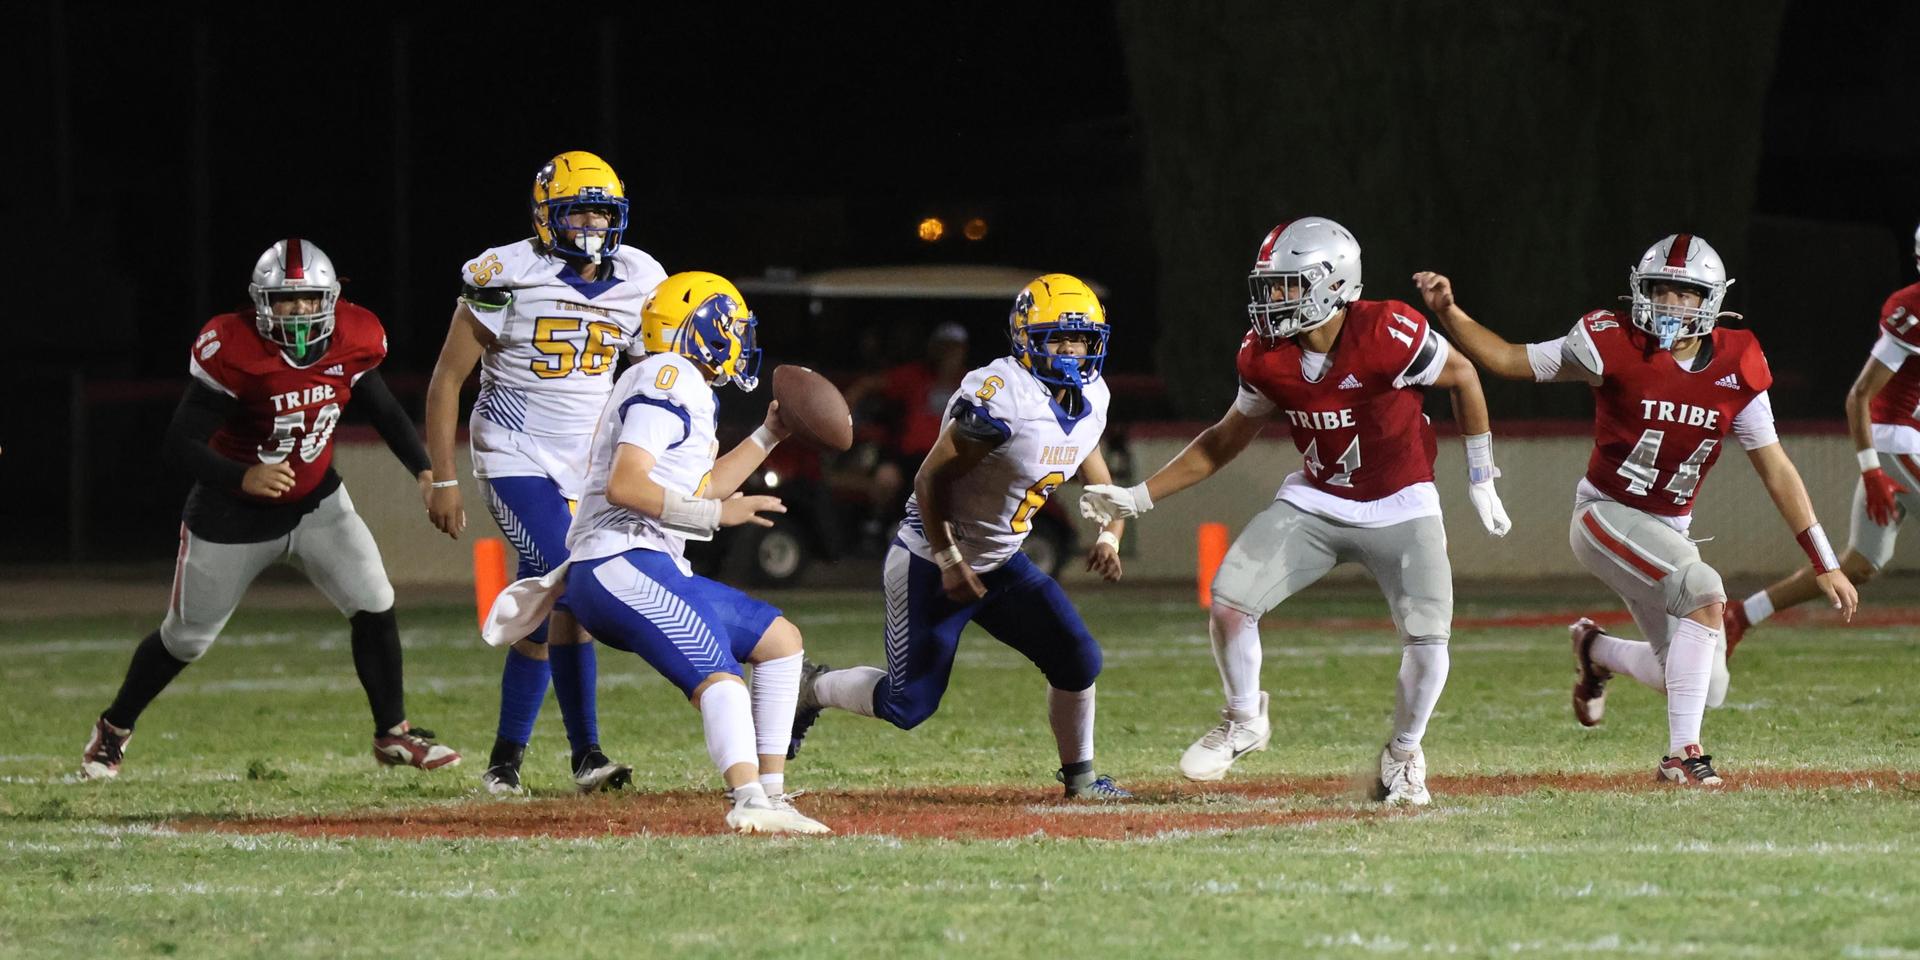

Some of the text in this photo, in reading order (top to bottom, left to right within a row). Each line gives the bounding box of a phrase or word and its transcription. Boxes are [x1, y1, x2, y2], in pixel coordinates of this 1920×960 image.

[468, 253, 504, 287] 56
[1387, 312, 1419, 349] 11
[1887, 306, 1919, 335] 21
[531, 316, 622, 379] 56
[654, 364, 679, 390] 0
[976, 375, 1004, 401] 6
[270, 384, 336, 412] TRIBE
[1285, 408, 1356, 430] TRIBE
[1640, 400, 1720, 430] TRIBE
[257, 402, 341, 464] 50
[1617, 428, 1719, 505] 44
[1010, 471, 1066, 534] 6
